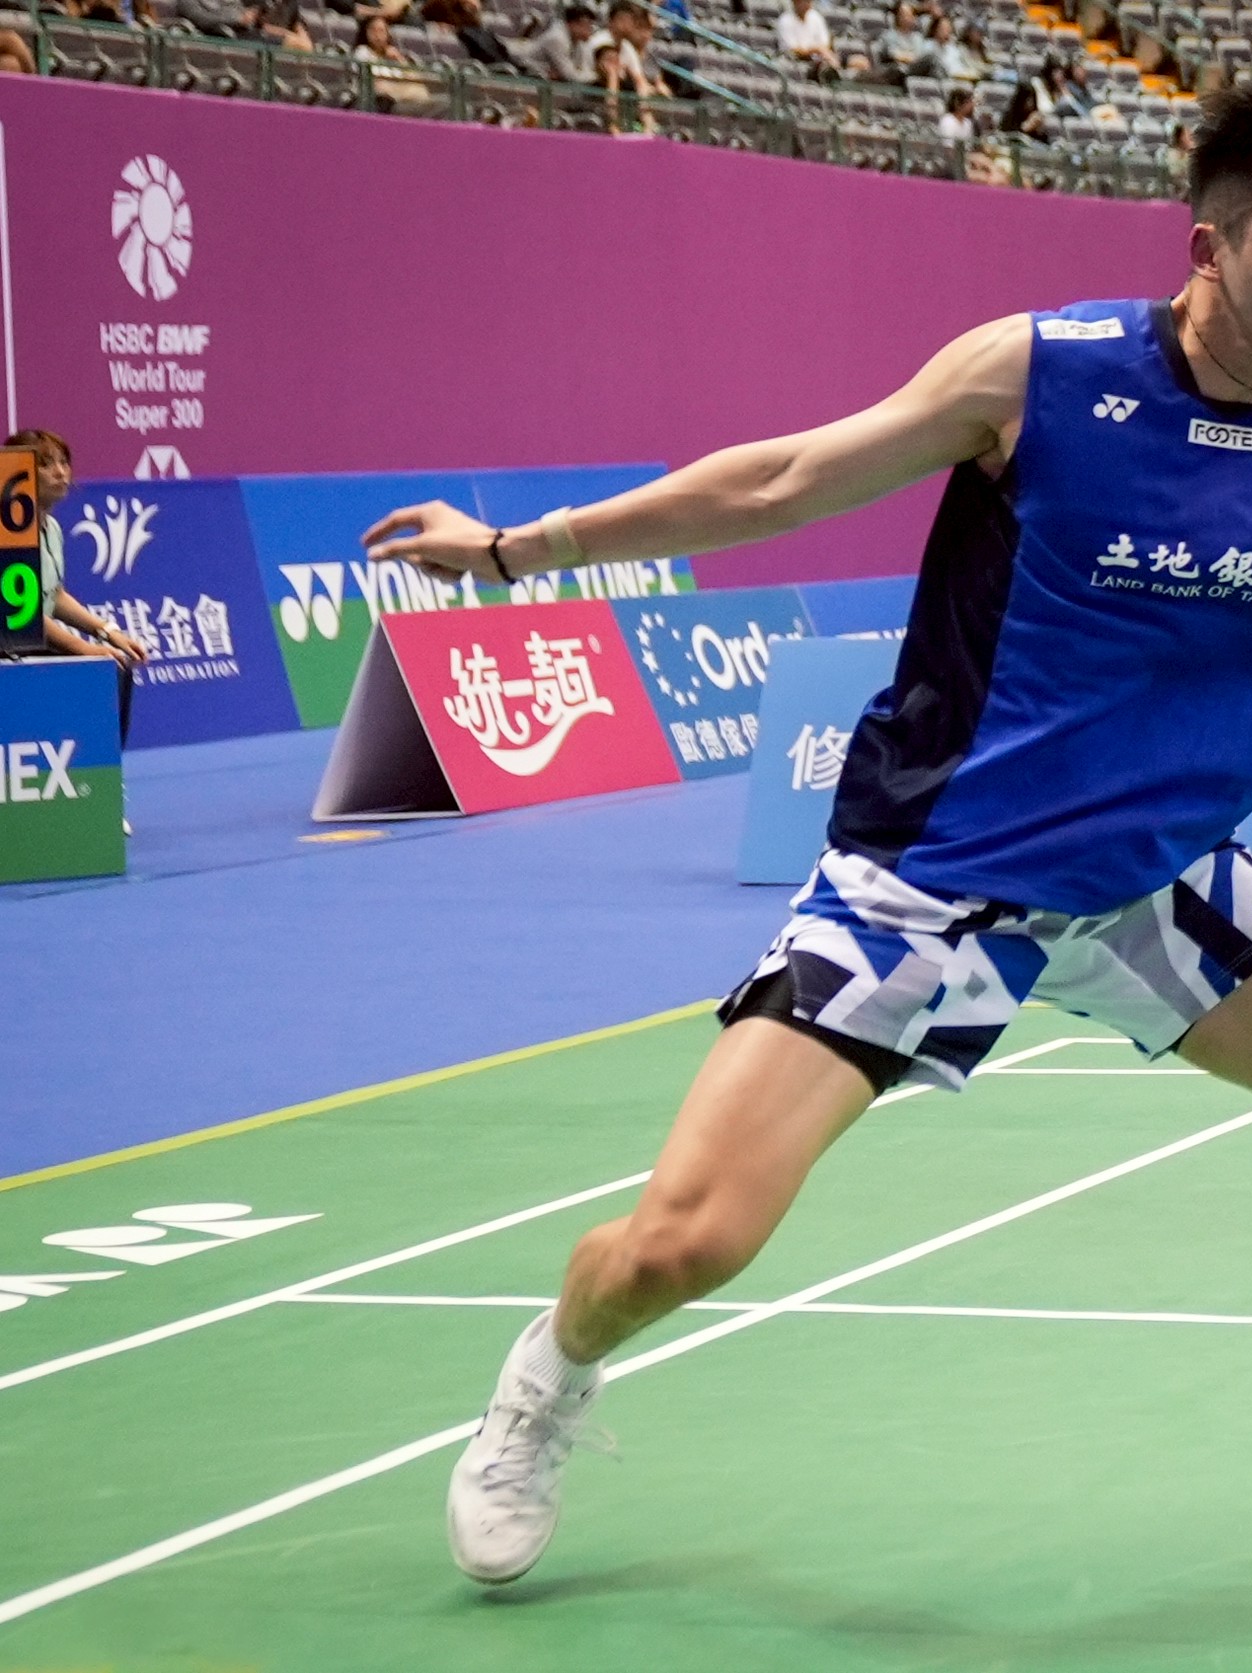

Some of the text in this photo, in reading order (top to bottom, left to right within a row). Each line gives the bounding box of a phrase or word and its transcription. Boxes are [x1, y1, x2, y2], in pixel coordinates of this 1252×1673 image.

[100, 322, 210, 355] HSBC BWF
[109, 361, 206, 393] World Tour
[115, 397, 204, 436] Super 300
[0, 471, 35, 533] 6
[1, 562, 40, 631] 9
[1089, 570, 1145, 589] LAND
[1150, 582, 1203, 599] BANK
[1207, 585, 1235, 599] OF
